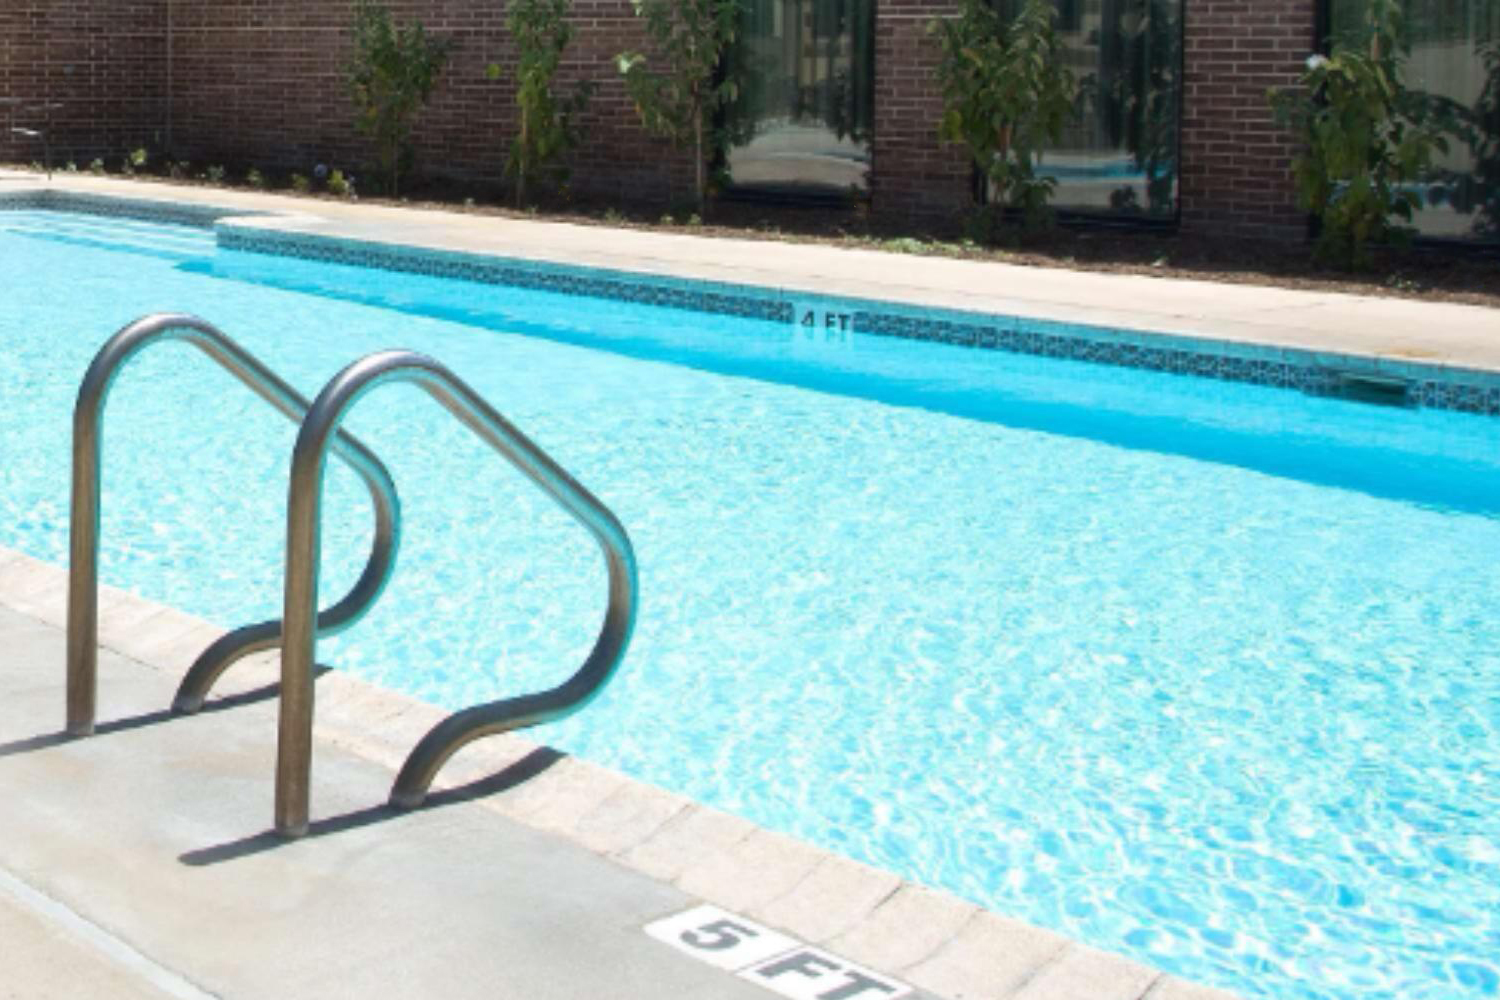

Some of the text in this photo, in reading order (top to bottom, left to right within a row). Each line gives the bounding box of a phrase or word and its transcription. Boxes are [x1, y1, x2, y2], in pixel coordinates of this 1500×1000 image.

[801, 309, 851, 332] 4 FT
[678, 917, 898, 1000] 5 FT
